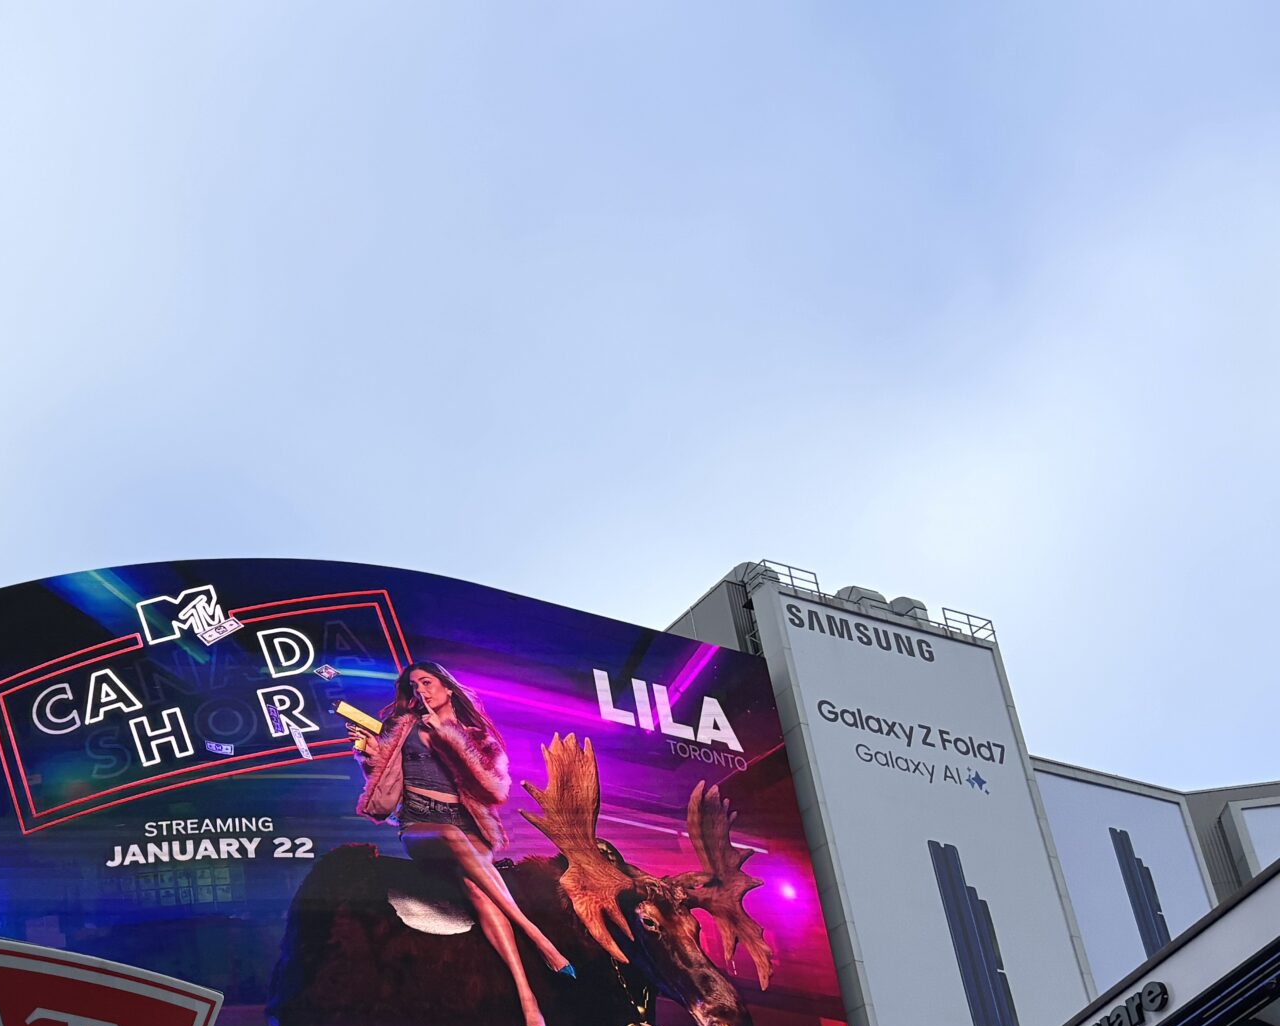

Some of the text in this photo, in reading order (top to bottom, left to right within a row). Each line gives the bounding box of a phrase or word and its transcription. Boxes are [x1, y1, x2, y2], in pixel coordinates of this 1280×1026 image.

[786, 603, 935, 663] SAMSUNG
[593, 668, 743, 752] LILA
[817, 699, 1006, 765] Galaxy Z Fold7
[668, 739, 748, 772] TORONTO
[855, 744, 962, 785] Galaxy AI
[144, 816, 274, 838] STREAMING
[106, 837, 315, 867] JANUARY 22
